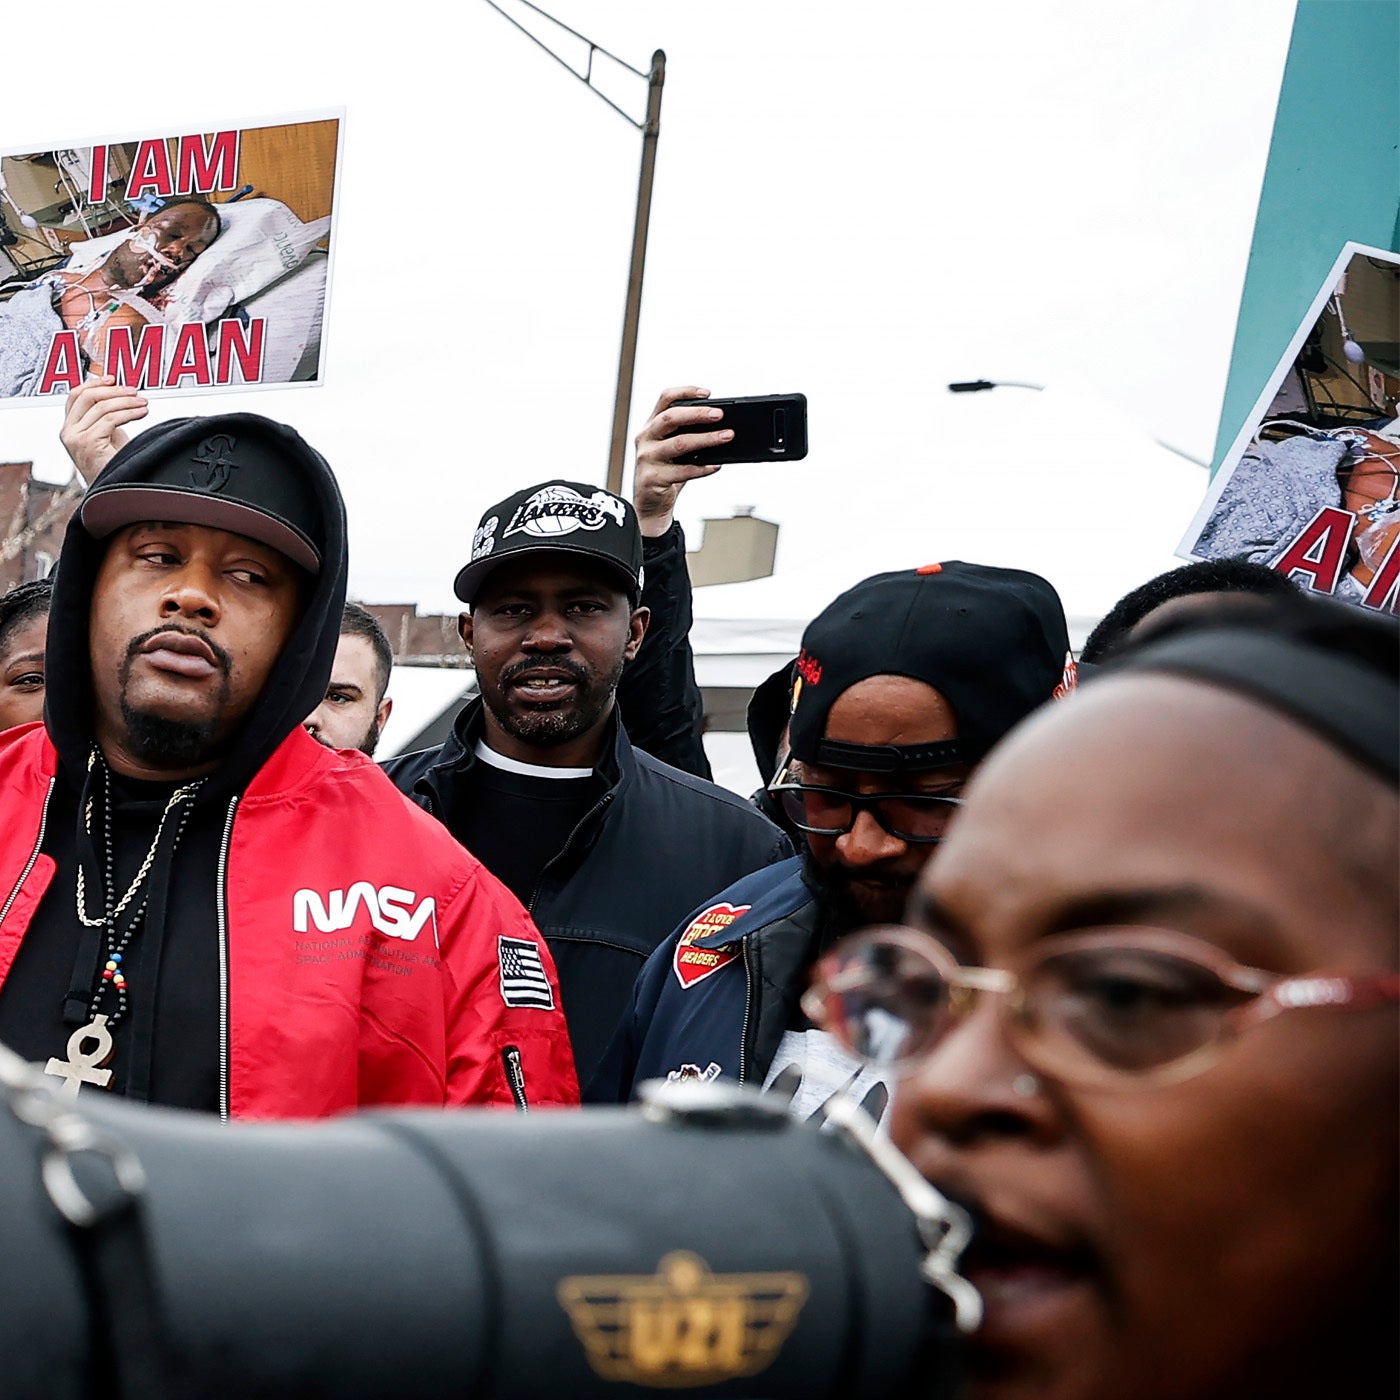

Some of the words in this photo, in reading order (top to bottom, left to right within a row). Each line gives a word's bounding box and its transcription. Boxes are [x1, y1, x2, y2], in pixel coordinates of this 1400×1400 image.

[88, 144, 108, 203] I
[124, 130, 238, 199] AM
[38, 330, 84, 395] A
[106, 317, 267, 391] MAN
[506, 500, 604, 531] LAKERS
[293, 880, 440, 950] NASA
[709, 914, 735, 925] LOVE
